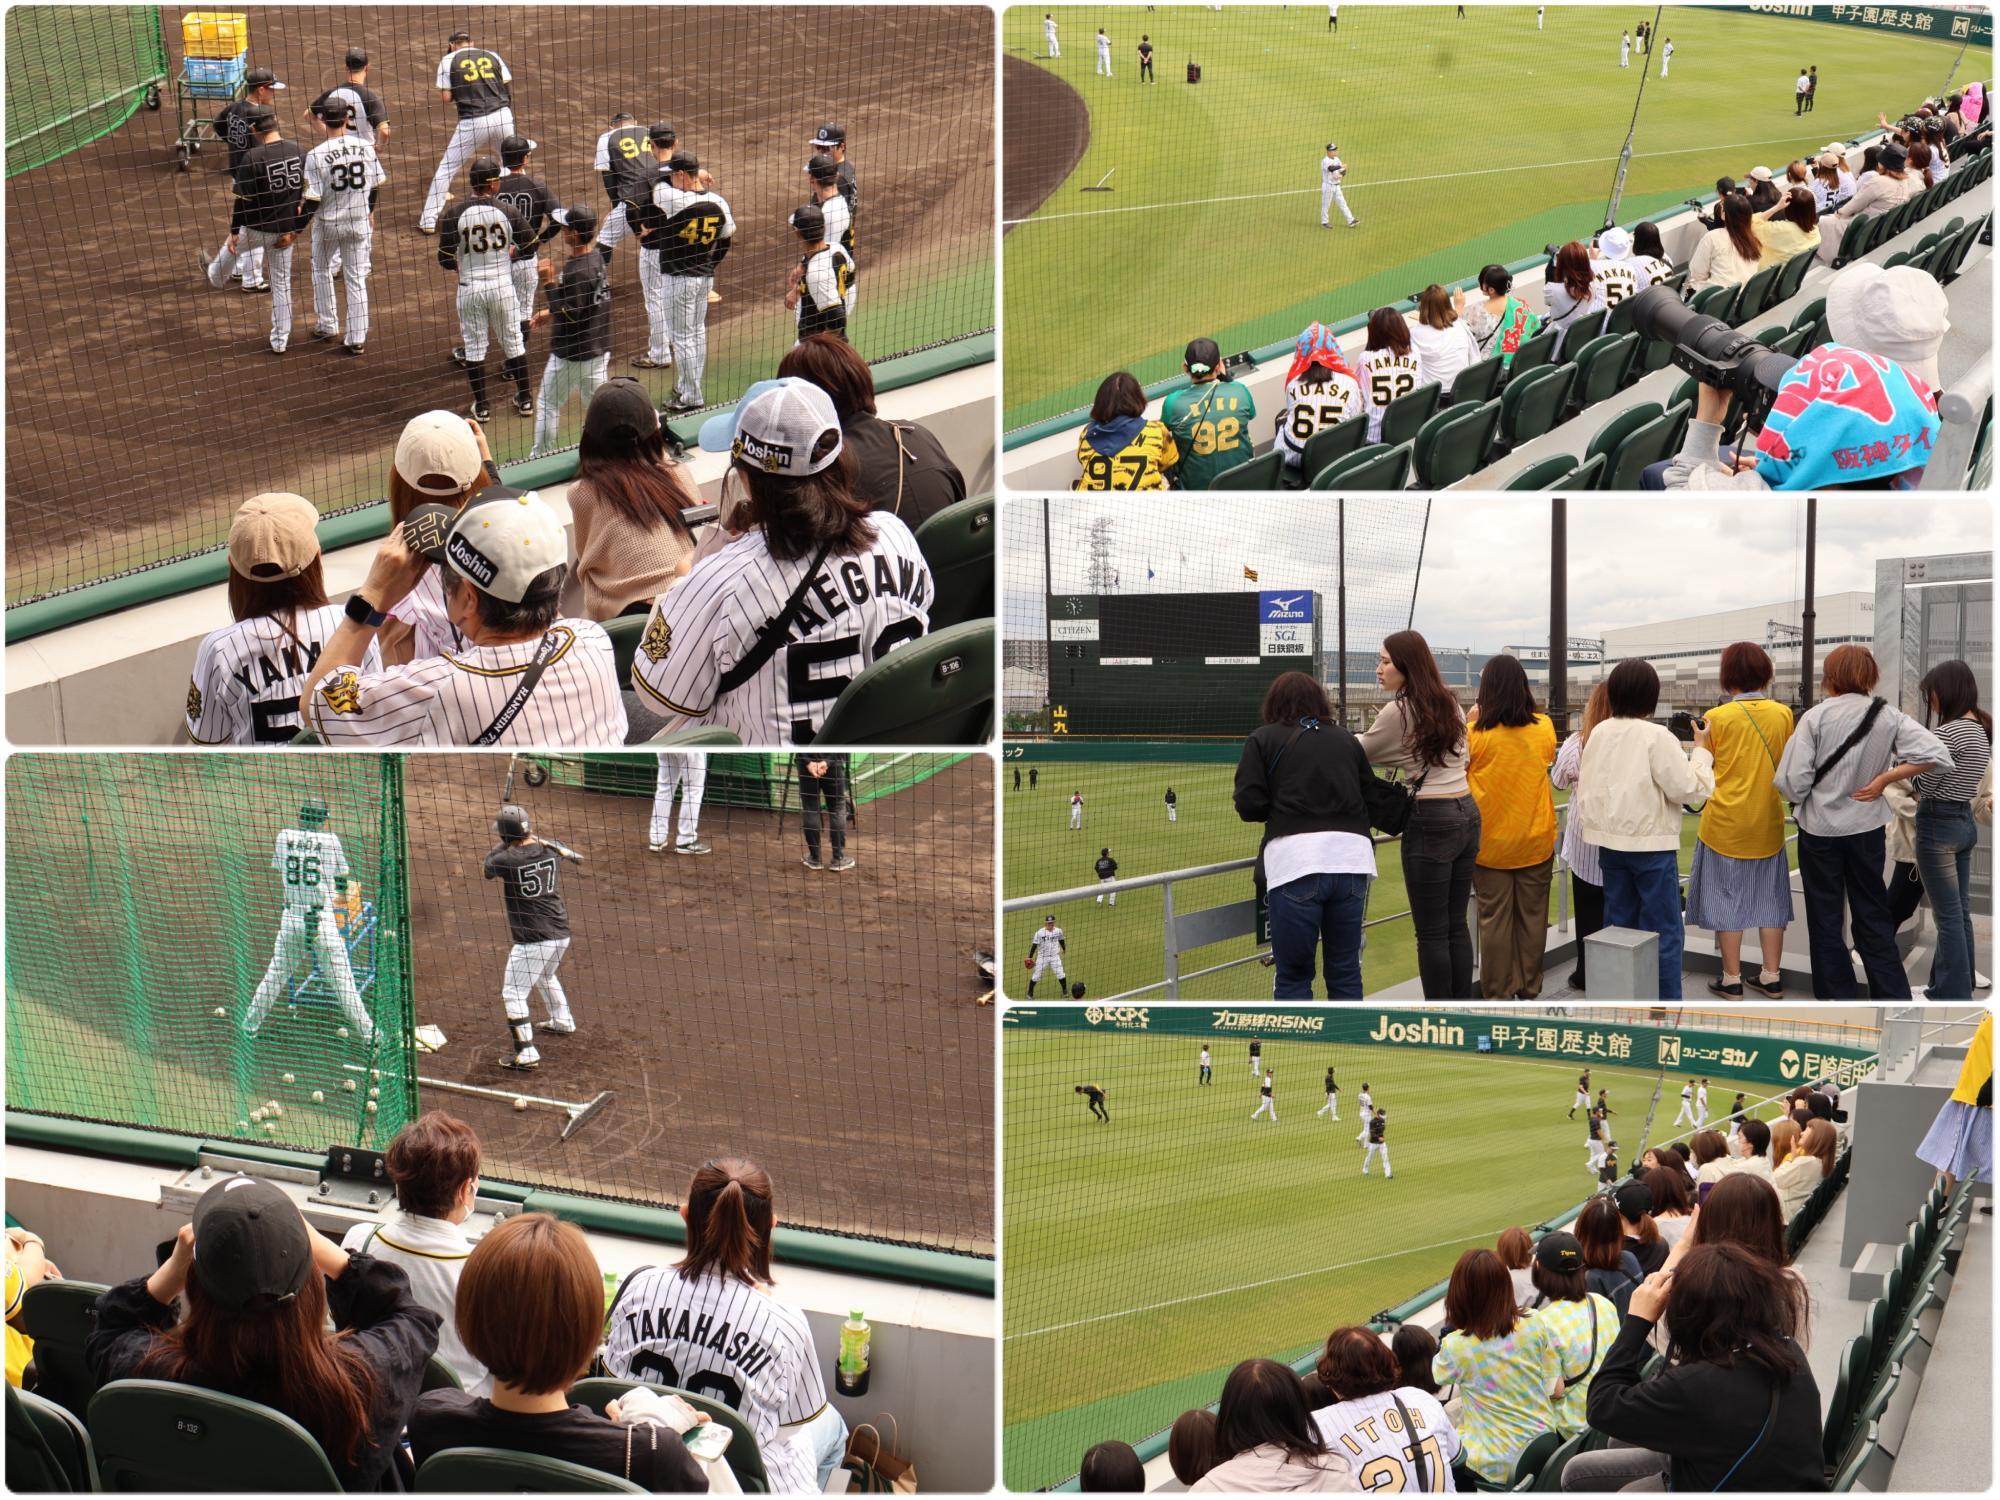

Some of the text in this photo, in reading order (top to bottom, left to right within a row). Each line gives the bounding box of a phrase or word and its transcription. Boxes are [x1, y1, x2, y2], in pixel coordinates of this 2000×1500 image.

[1832, 4, 1934, 31] 甲子園歴史館
[460, 57, 496, 82] 32
[324, 144, 366, 165] OBATA
[266, 157, 302, 193] 55
[330, 161, 366, 192] 38
[462, 223, 507, 254] 133
[678, 216, 720, 246] 45
[1365, 356, 1418, 374] YAMADA
[1289, 382, 1350, 403] YUASA
[1371, 373, 1415, 406] 52
[1191, 416, 1240, 455] 92
[1292, 404, 1343, 439] 65
[1088, 455, 1148, 490] 97
[450, 540, 492, 583] Joshin
[1058, 626, 1092, 634] CITIZEN
[1275, 630, 1297, 641] SGL
[494, 685, 530, 735] HANSHIN
[1053, 705, 1068, 734] 山九
[286, 855, 321, 886] 86
[518, 857, 556, 897] 57
[1369, 1015, 1465, 1046] Joshin
[1491, 1025, 1633, 1059] 甲子園歴史館
[625, 1307, 773, 1379] TAKAHASHI
[177, 1421, 199, 1434] B-132
[1339, 1407, 1427, 1456] ITOH
[1358, 1435, 1446, 1493] 27
